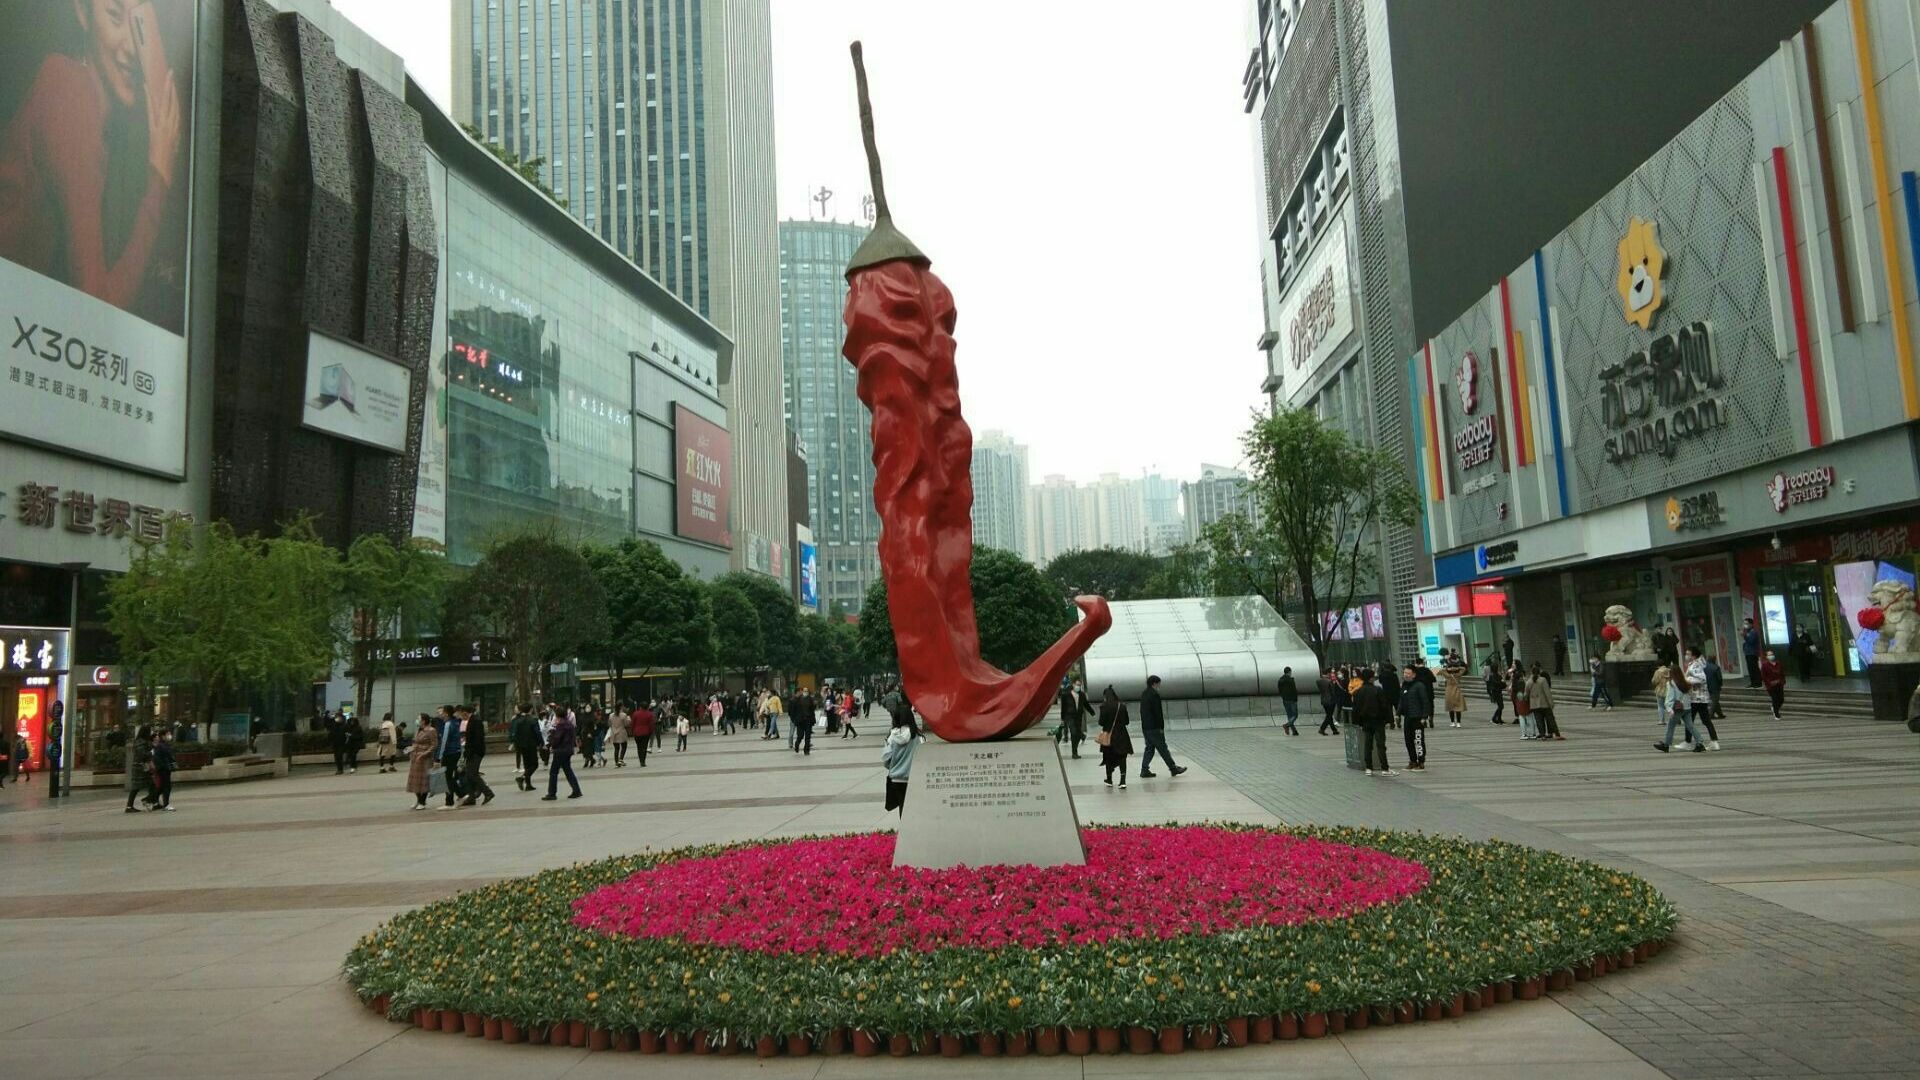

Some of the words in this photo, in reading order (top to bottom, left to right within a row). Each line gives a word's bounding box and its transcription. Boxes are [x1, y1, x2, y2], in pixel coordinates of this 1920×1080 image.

[11, 316, 128, 386] X30系列
[136, 376, 153, 392] 5G
[1598, 321, 1719, 430] 苏宁易购
[1453, 415, 1494, 454] redbaby
[1604, 398, 1726, 463] suning.com
[1785, 467, 1832, 490] redbaby
